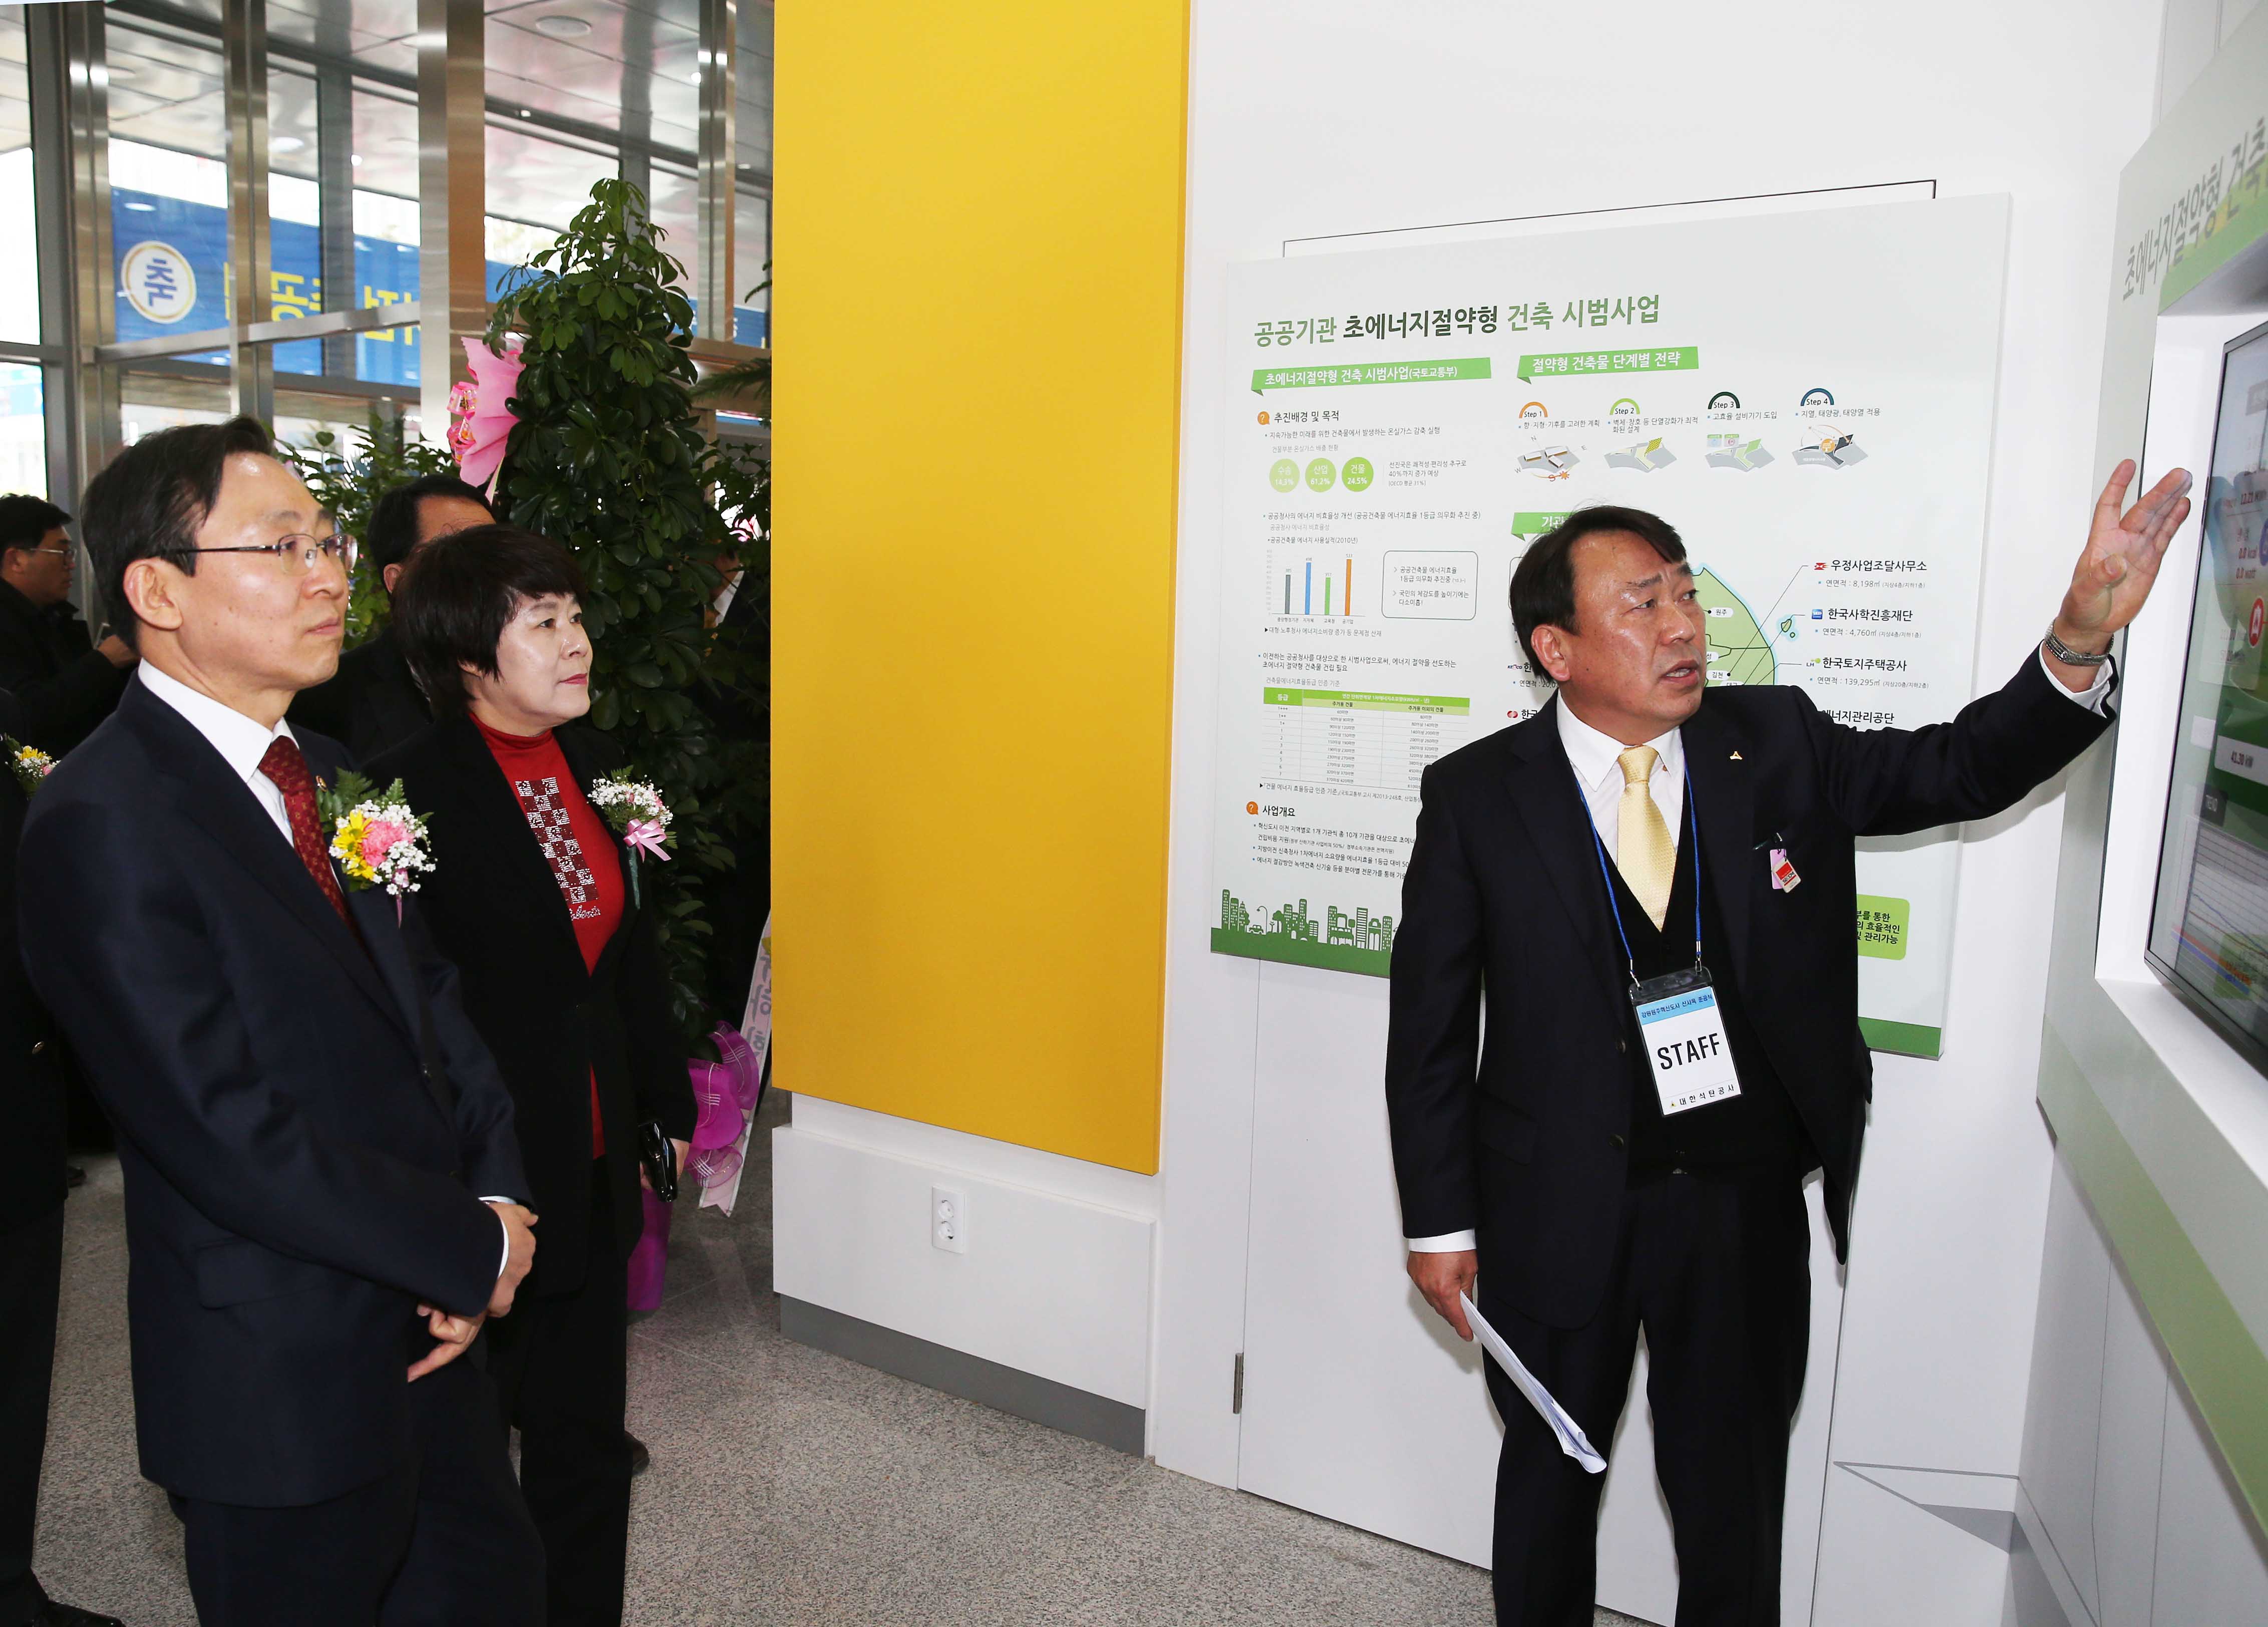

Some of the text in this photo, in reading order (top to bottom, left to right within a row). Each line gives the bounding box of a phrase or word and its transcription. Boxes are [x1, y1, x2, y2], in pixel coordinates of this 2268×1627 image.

[2123, 156, 2223, 301] 초에너지절약형
[1254, 295, 1659, 347] 공공기관 초에너지절약형 건축 시범사업
[1533, 351, 1681, 373] 절약형 건축물 단계별 전략
[1265, 366, 1457, 385] 초에너지절약형 건축 시범사업(국토교통부)
[1274, 410, 1340, 423] 추진배경 및 목적
[1713, 413, 1733, 421] 고효율
[1763, 411, 1777, 419] 도입
[1843, 408, 1864, 417] 태양열
[1866, 408, 1880, 416] 적용
[1270, 431, 1298, 439] 지속가능한
[1363, 428, 1386, 436] 발생하는
[1388, 428, 1412, 436] 온실가스
[1428, 426, 1440, 434] 실행
[1314, 466, 1328, 474] 산업
[1351, 465, 1366, 474] 건물
[1268, 513, 1295, 521] 공공청사의
[1316, 512, 1339, 520] 비효율성
[1354, 512, 1386, 520] (공공건축물
[1388, 512, 1417, 520] 에너지효율
[1472, 512, 1481, 520] 중)
[1831, 560, 1927, 572] 우정사업조달사무소
[1828, 608, 1913, 621] 한국사학진흥재단
[1286, 662, 1303, 671] 절약형
[1316, 654, 1339, 662] 대상으로
[1348, 656, 1391, 666] 시범사업으로써,
[1393, 658, 1410, 666] 에너지
[1412, 658, 1430, 667] 절약을
[1432, 660, 1457, 668] 선도하는
[1823, 657, 1907, 671] 한국토지주택공사
[1519, 680, 1536, 688] 연면적
[1263, 805, 1295, 817] 사업개요
[1290, 825, 1311, 834] 지역별로
[1359, 833, 1374, 841] 기관을
[1347, 855, 1372, 864] 에너지효율
[1345, 866, 1360, 874] 분야별
[1362, 868, 1382, 877] 전문가를
[1873, 912, 1890, 922] 통한
[1866, 922, 1899, 934] 효율적인
[1864, 932, 1898, 944] 관리가능
[1658, 1033, 1719, 1069] STAFF
